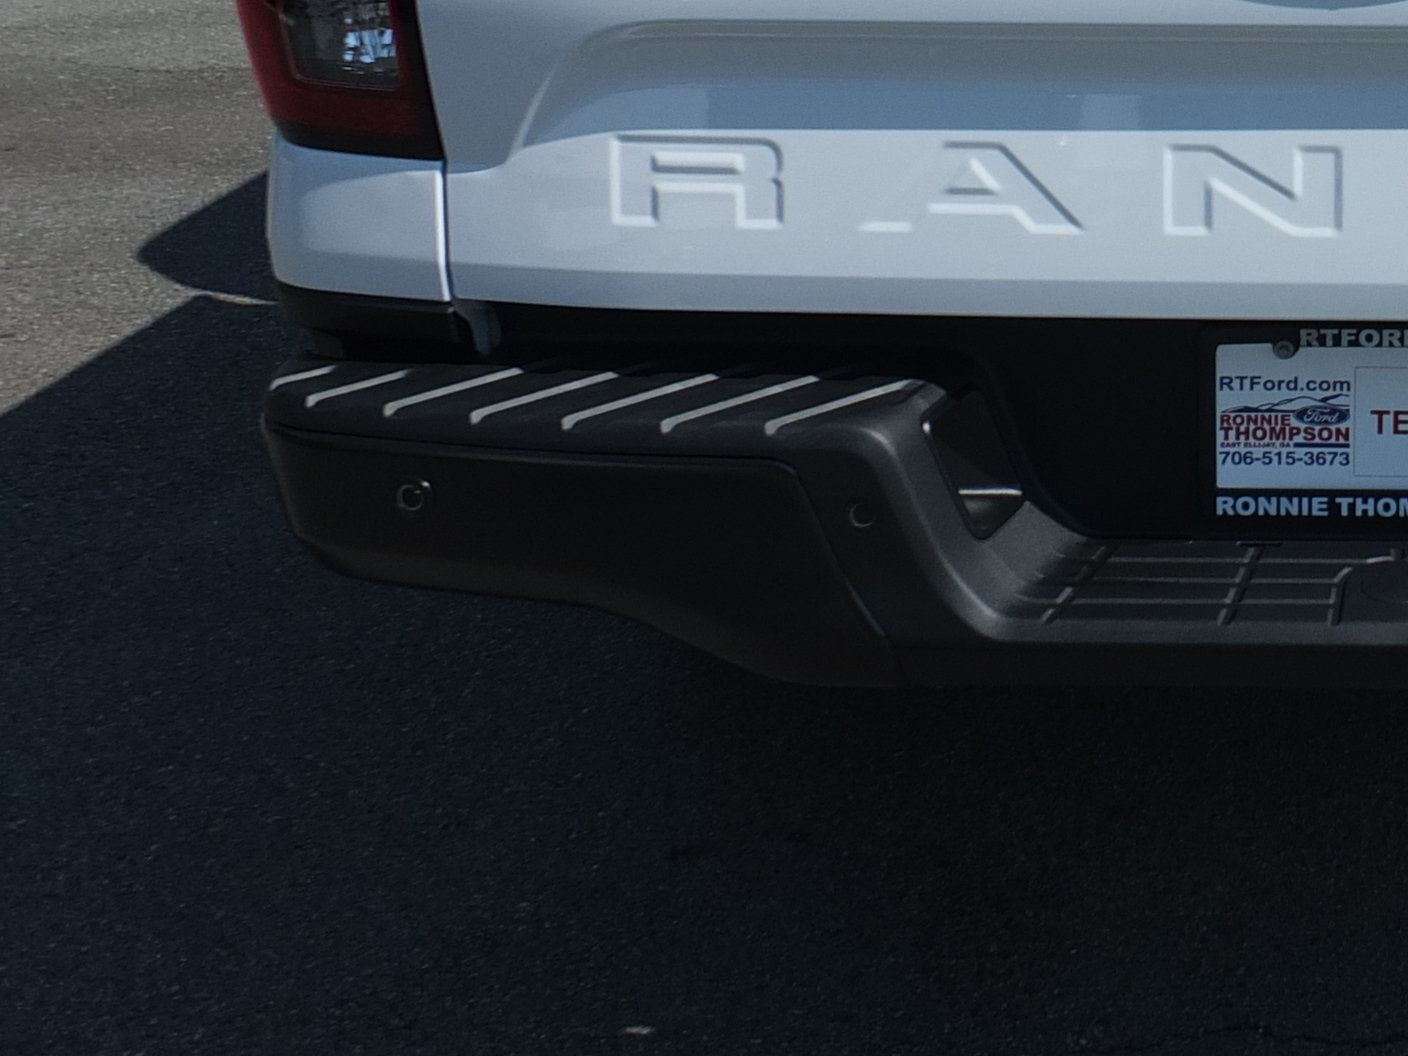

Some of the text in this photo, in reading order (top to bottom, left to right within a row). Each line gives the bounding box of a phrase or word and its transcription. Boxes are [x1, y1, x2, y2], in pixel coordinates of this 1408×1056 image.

[1218, 375, 1351, 392] RTFord.com
[1219, 413, 1291, 427] RONNIE
[1303, 407, 1340, 423] Ford
[1219, 426, 1350, 442] THOMPSON
[1218, 450, 1350, 466] 706-515-3673
[1216, 496, 1329, 517] RONNIE
